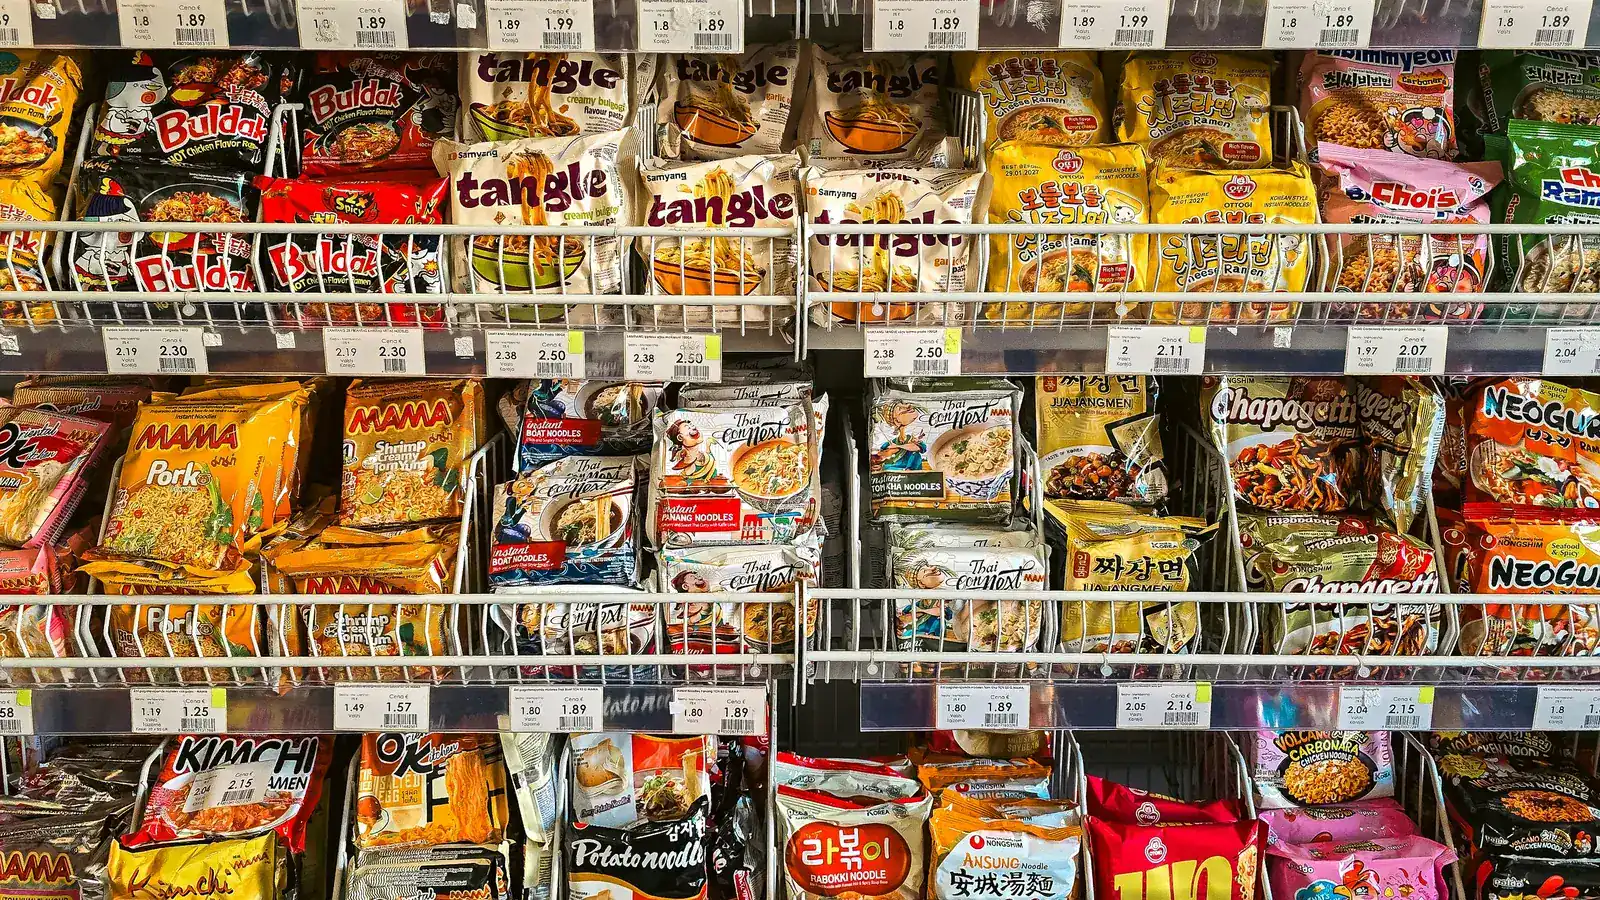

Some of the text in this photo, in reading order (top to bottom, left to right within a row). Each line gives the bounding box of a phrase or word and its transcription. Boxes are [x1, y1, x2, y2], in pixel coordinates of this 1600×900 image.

[133, 16, 149, 26] 1.8
[177, 14, 205, 26] 1.89
[357, 16, 386, 29] 1.89
[497, 20, 520, 30] 1.89
[544, 18, 574, 31] 1.99
[653, 20, 669, 30] 1.8
[697, 19, 725, 31] 1.89
[888, 20, 904, 30] 1.8
[932, 17, 960, 30] 1.89
[1072, 17, 1095, 27] 1.89
[1119, 15, 1148, 28] 1.99
[1281, 18, 1297, 28] 1.8
[1325, 15, 1354, 27] 1.89
[1498, 17, 1514, 27] 1.8
[1541, 15, 1570, 28] 1.89
[477, 52, 624, 94] tangle
[677, 56, 789, 94] tangle
[308, 79, 403, 125] Buldak
[566, 94, 627, 112] creamy bulgogi
[993, 94, 1066, 117] Cheese Ramen
[584, 106, 624, 121] flavour pasta
[1137, 93, 1237, 127] 치즈라면
[323, 108, 394, 131] HOT Chicken Flavor Ramen
[154, 102, 268, 153] Buldak
[1149, 116, 1232, 139] Cheese Ramen
[167, 139, 242, 164] HOT Chicken Flavor
[458, 149, 498, 160] Samyang
[647, 172, 687, 182] Samyang
[457, 161, 607, 213] tangle
[818, 188, 857, 200] Samyang
[1019, 181, 1104, 211] 보들보들
[1370, 180, 1461, 211] Choi's
[335, 196, 365, 217] Spicy
[648, 185, 794, 228] tangle
[1171, 198, 1204, 206] 29.01.2027
[268, 240, 377, 288] Buldak
[115, 347, 137, 356] 2.19
[160, 346, 188, 356] 2.30
[335, 348, 357, 357] 2.19
[378, 346, 407, 357] 2.30
[495, 351, 517, 360] 2.38
[538, 350, 566, 361] 2.50
[873, 350, 895, 359] 2.38
[915, 347, 943, 359] 2.50
[1122, 346, 1129, 355] 2
[1157, 345, 1184, 356] 2.11
[1357, 347, 1377, 355] 1.97
[1399, 345, 1427, 356] 2.07
[1555, 349, 1577, 358] 2.04
[633, 353, 655, 363] 2.38
[676, 353, 703, 364] 2.50
[734, 388, 759, 400] Thai
[1540, 383, 1568, 394] Seafood
[941, 400, 967, 411] Thai
[1050, 397, 1133, 409] JJAJANGMEN
[1211, 388, 1357, 432] Chapagetti
[348, 400, 452, 434] MAMA
[734, 413, 761, 428] Thai
[526, 420, 563, 431] instant
[1314, 425, 1356, 438] 짜파게티
[135, 422, 240, 451] MAMA
[526, 429, 581, 437] BOAT NOODLES
[1525, 427, 1571, 449] 너구리
[374, 440, 427, 454] Shrimp
[376, 452, 420, 463] Creamy
[575, 459, 602, 472] Thai
[146, 459, 200, 487] Pork
[871, 482, 941, 492] TOM KHA NOODLES
[662, 513, 734, 522] PANANG NOODLES
[1498, 540, 1543, 548] NONGSHIM
[1551, 542, 1580, 550] Seafood
[493, 545, 529, 557] instant
[492, 553, 548, 566] BOAT NOODLES
[742, 561, 772, 573] Thai
[969, 560, 999, 575] Thai
[1092, 554, 1185, 582] 짜장면
[183, 707, 209, 717] 1.25
[344, 703, 365, 712] 1.49
[386, 702, 412, 712] 1.57
[520, 706, 541, 715] 1.80
[561, 704, 587, 715] 1.89
[723, 707, 749, 717] 1.89
[946, 703, 967, 712] 1.80
[987, 702, 1013, 712] 1.89
[1125, 703, 1146, 711] 2.05
[1167, 701, 1193, 711] 2.16
[1347, 705, 1368, 714] 2.04
[1388, 704, 1415, 714] 2.15
[1550, 706, 1565, 714] 1.8
[141, 708, 162, 717] 1.19
[174, 737, 318, 773] KIMCHI
[1289, 739, 1359, 761] CARBONARA
[1301, 752, 1353, 767] CHICKEN NOODLE
[228, 778, 252, 790] 2.15
[193, 786, 211, 796] 2.04
[379, 788, 400, 802] EGG
[801, 827, 890, 870] 라볶이
[986, 840, 1023, 849] NONGSHIM
[1515, 842, 1569, 856] CHICKEN NOODLE
[572, 839, 639, 867] Potato
[233, 852, 269, 869] MAMA
[962, 852, 1049, 871] ANSUNG Noodle
[127, 866, 234, 899] Kimchi
[810, 872, 848, 884] RABOKKI
[850, 869, 887, 881] NOODLE
[450, 884, 490, 899] MAMA
